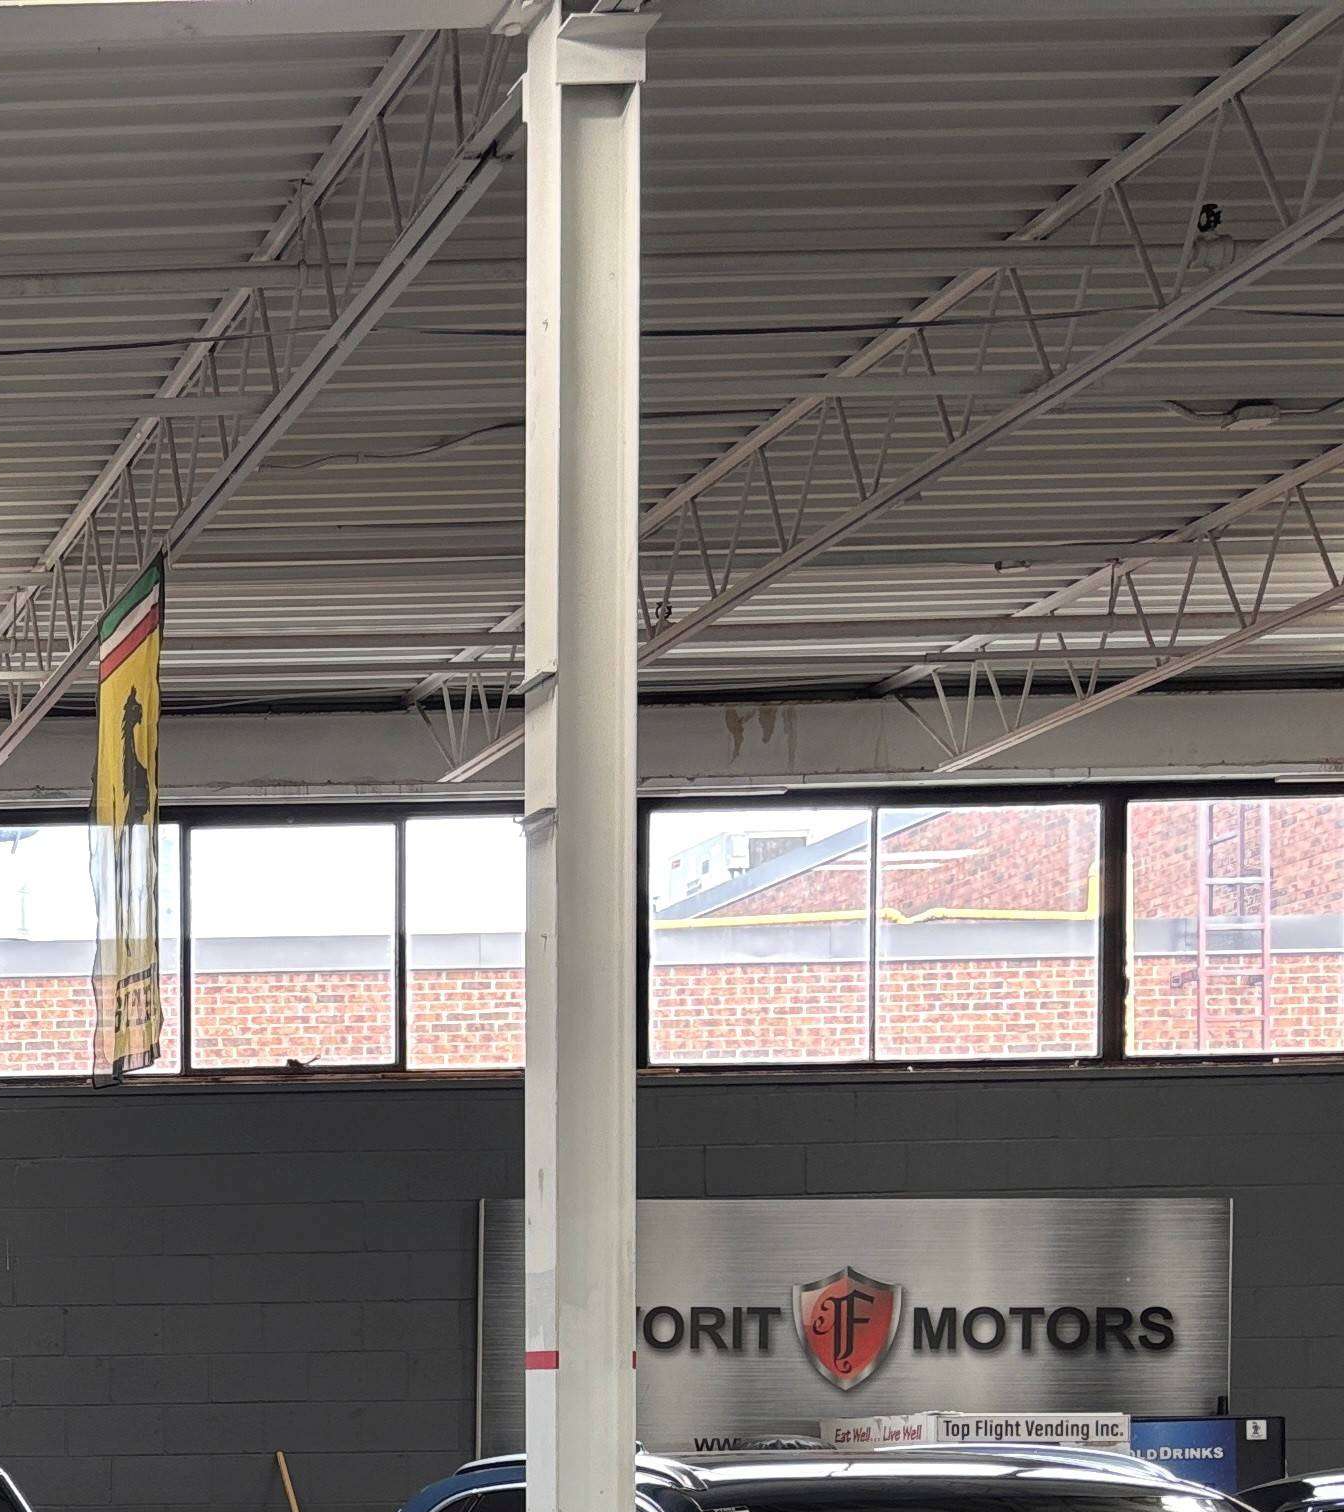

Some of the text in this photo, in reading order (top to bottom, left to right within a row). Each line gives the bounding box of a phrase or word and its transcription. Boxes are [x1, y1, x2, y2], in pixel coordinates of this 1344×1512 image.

[636, 1306, 781, 1350] ORIT
[912, 1306, 1176, 1351] MOTORS
[834, 1428, 851, 1443] Eat
[883, 1426, 901, 1441] Live
[902, 1424, 922, 1440] Well
[944, 1419, 1124, 1441] Top Flight Vending Inc.
[1159, 1446, 1224, 1459] DRINKS
